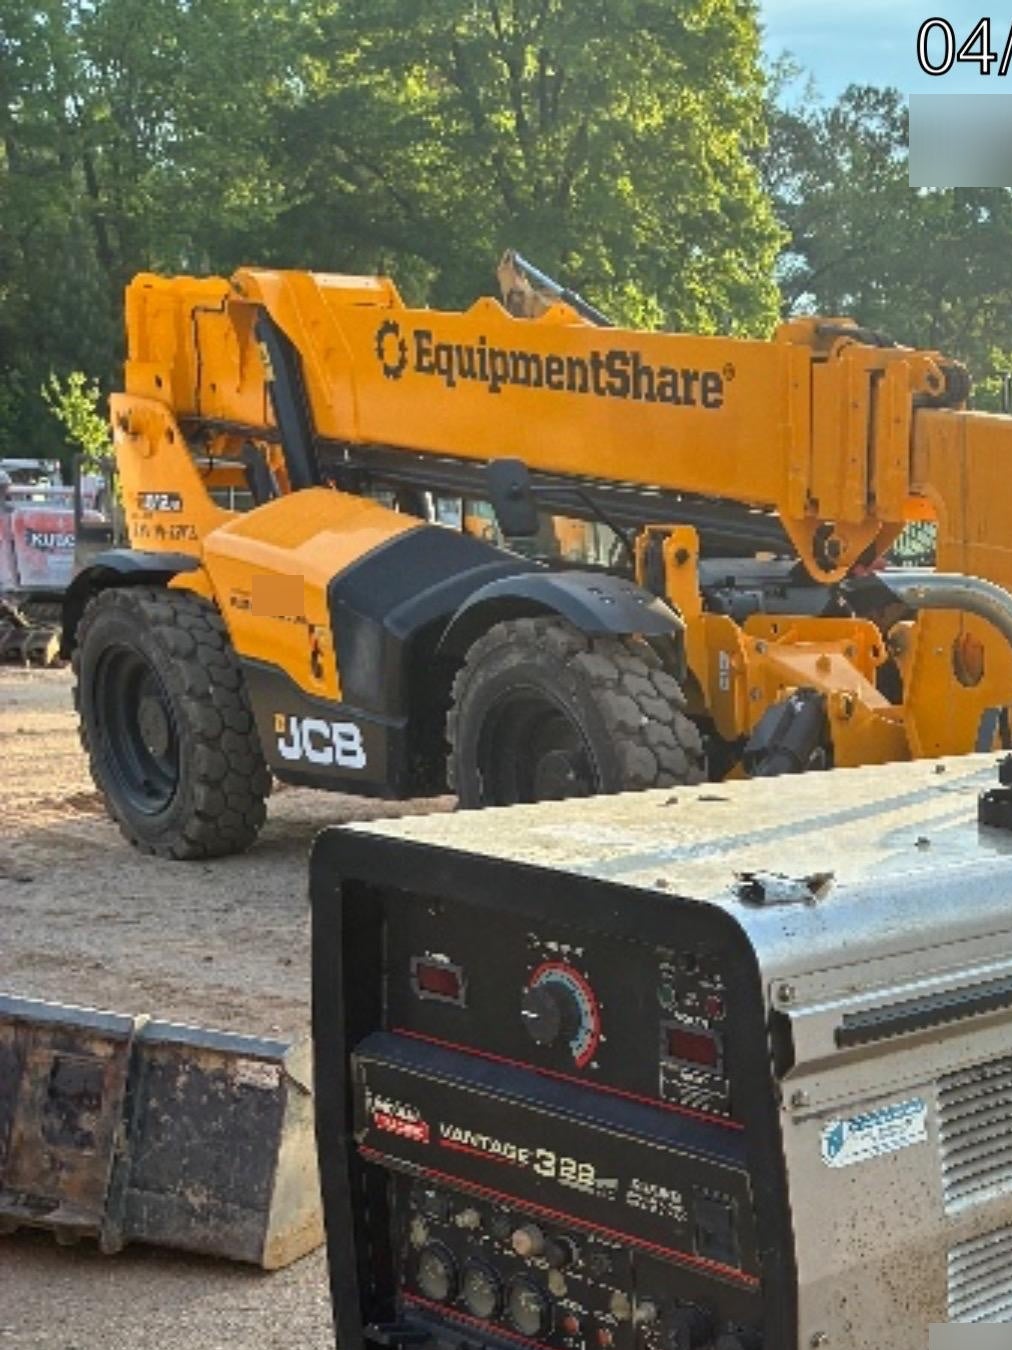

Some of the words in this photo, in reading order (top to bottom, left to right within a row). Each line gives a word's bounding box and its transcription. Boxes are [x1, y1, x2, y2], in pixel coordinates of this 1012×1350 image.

[413, 330, 724, 409] EquipmentShare
[277, 715, 367, 769] JCB
[437, 1121, 532, 1168] VANTAGE
